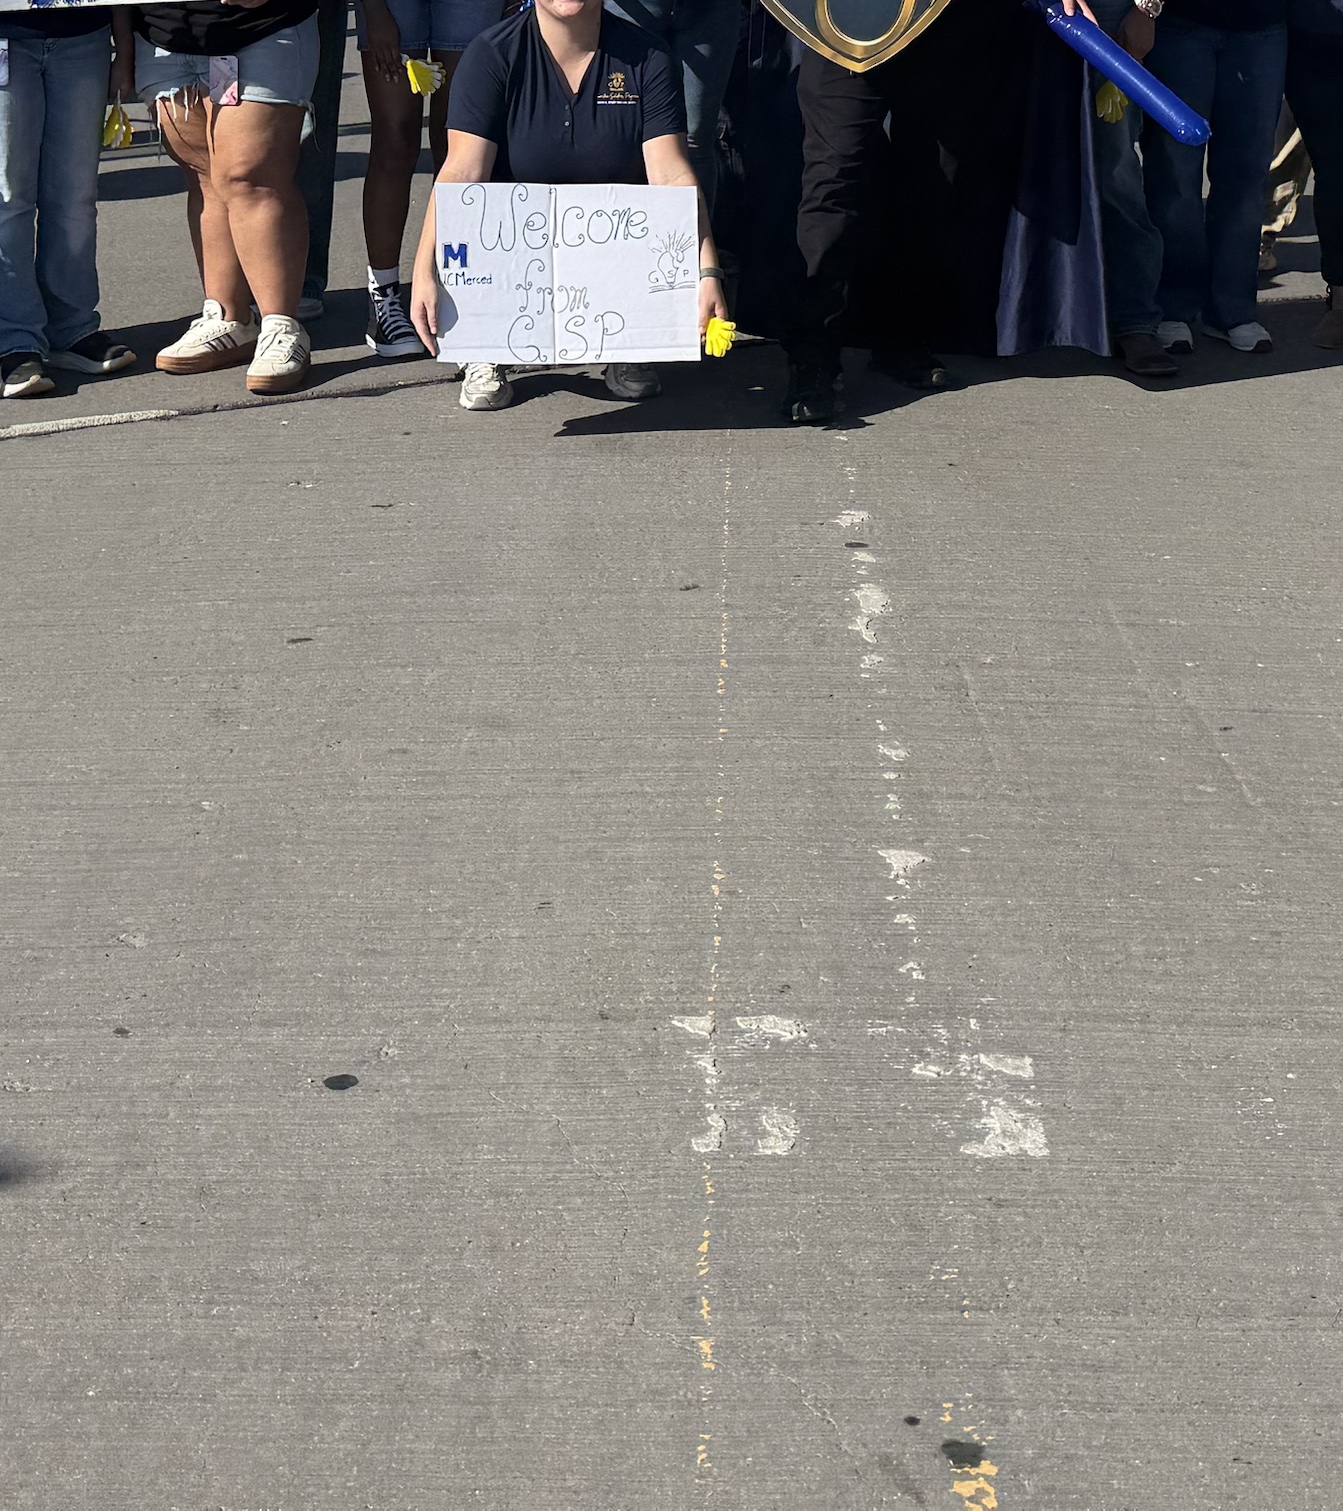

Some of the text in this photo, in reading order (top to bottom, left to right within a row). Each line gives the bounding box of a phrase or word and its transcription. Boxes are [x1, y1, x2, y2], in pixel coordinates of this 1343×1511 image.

[461, 182, 650, 252] Welcome
[442, 242, 469, 269] M
[515, 258, 590, 316] from
[506, 310, 626, 363] GSP
